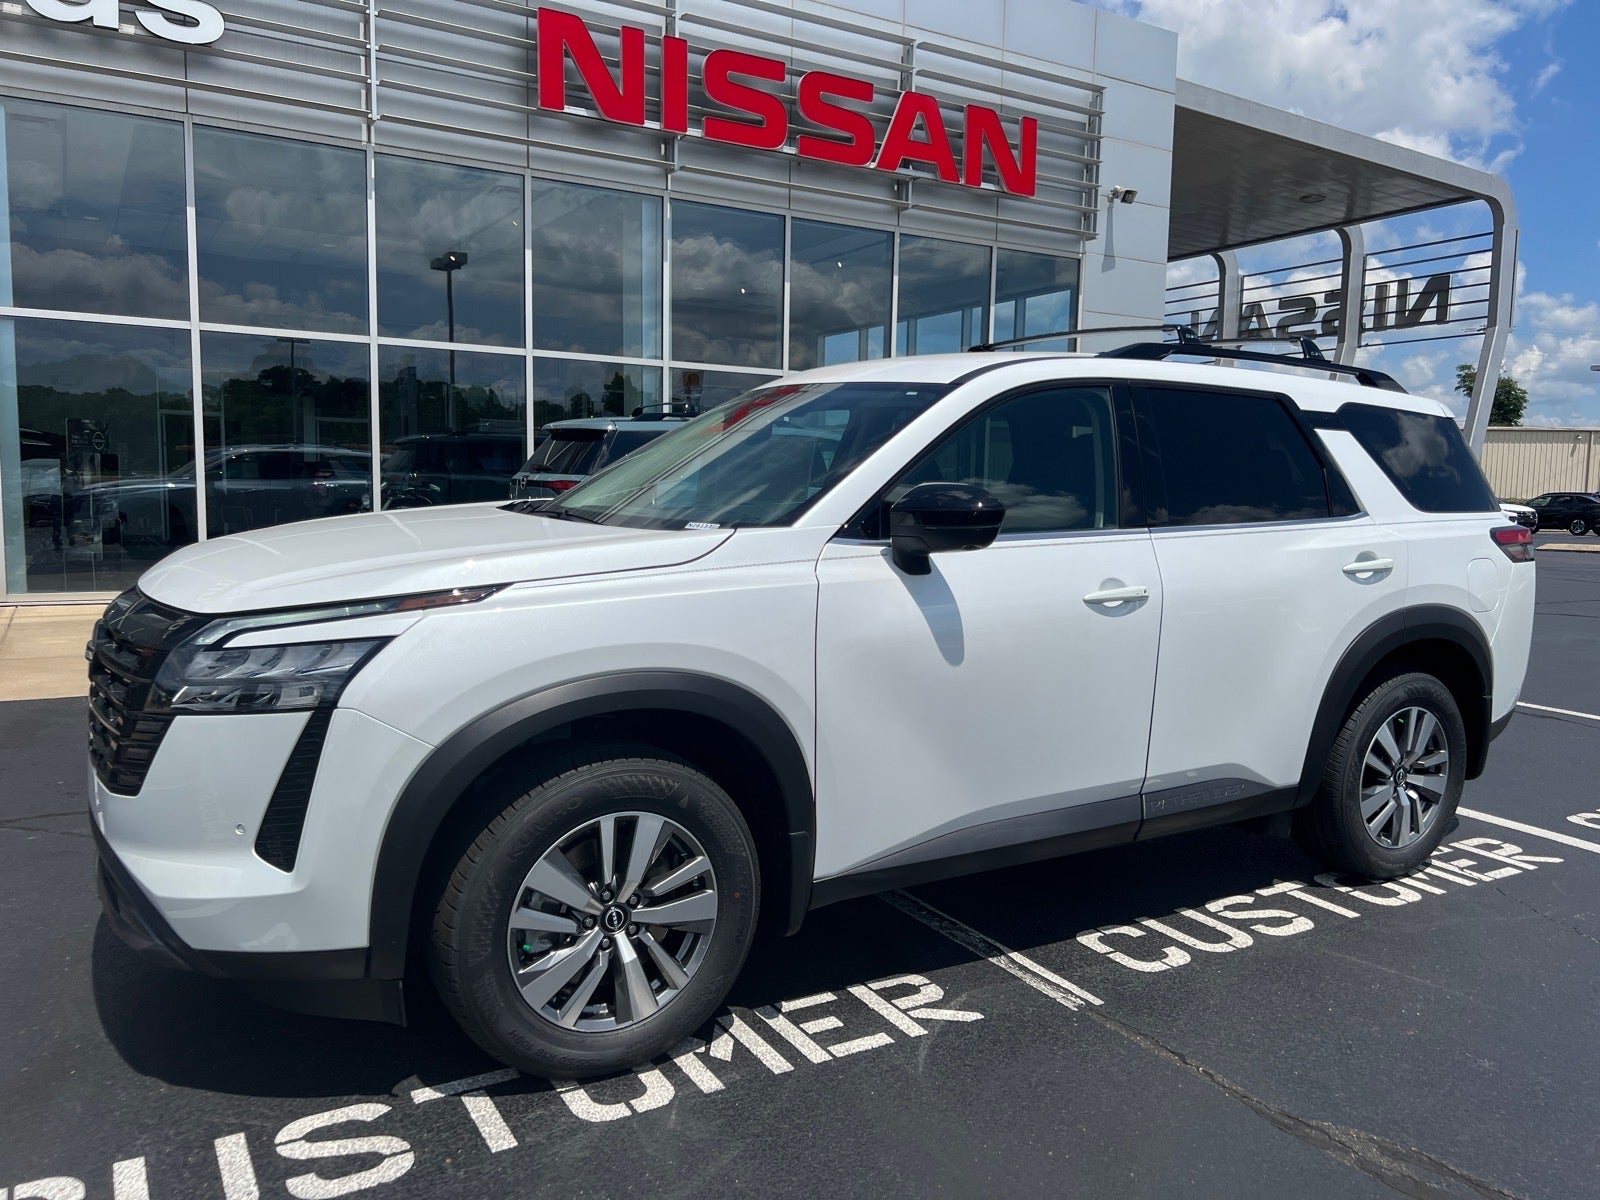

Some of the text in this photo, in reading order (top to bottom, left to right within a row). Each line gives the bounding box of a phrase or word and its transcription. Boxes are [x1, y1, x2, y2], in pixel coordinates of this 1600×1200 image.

[537, 7, 1038, 198] NISSAN
[1076, 837, 1565, 972] CUSTOMER
[0, 973, 985, 1200] USTOMER
